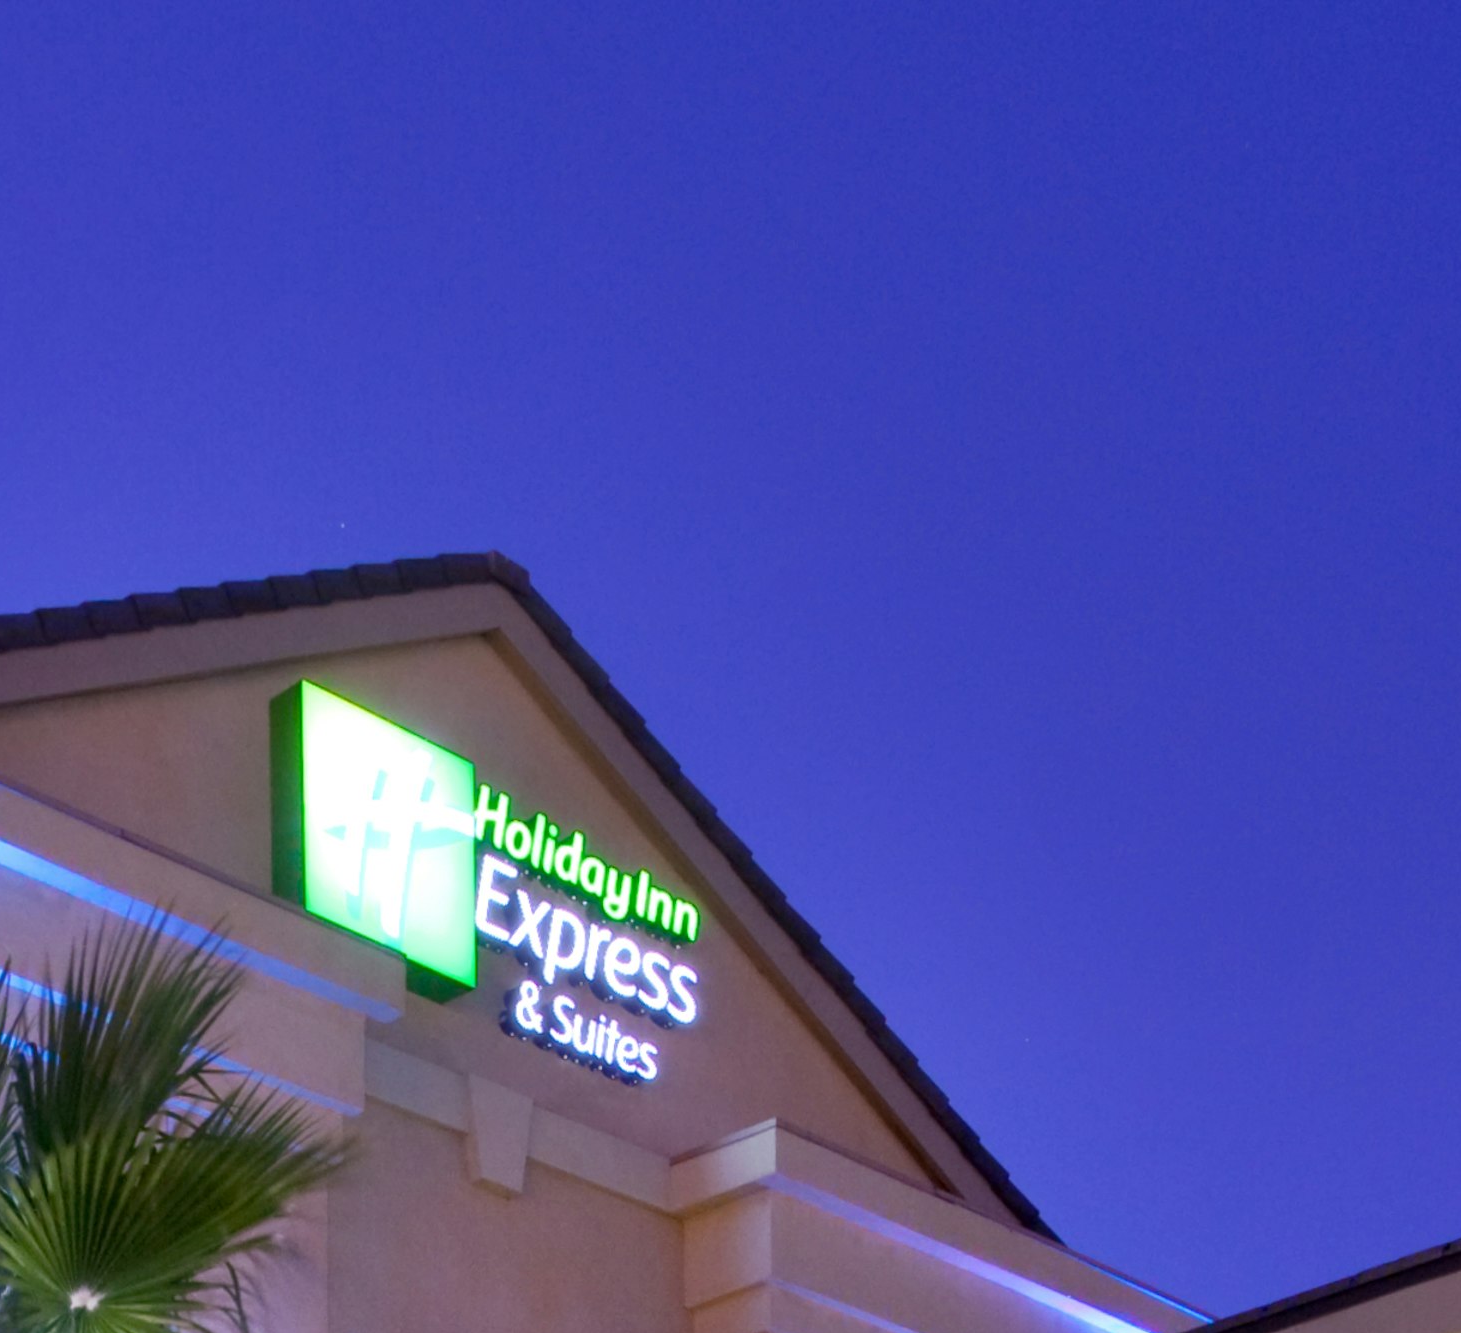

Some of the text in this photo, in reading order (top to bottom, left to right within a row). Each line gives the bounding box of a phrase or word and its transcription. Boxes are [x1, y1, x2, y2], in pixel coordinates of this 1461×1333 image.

[475, 784, 699, 942] Holiday Inn
[476, 853, 698, 1025] Express
[515, 979, 659, 1080] & Suites
